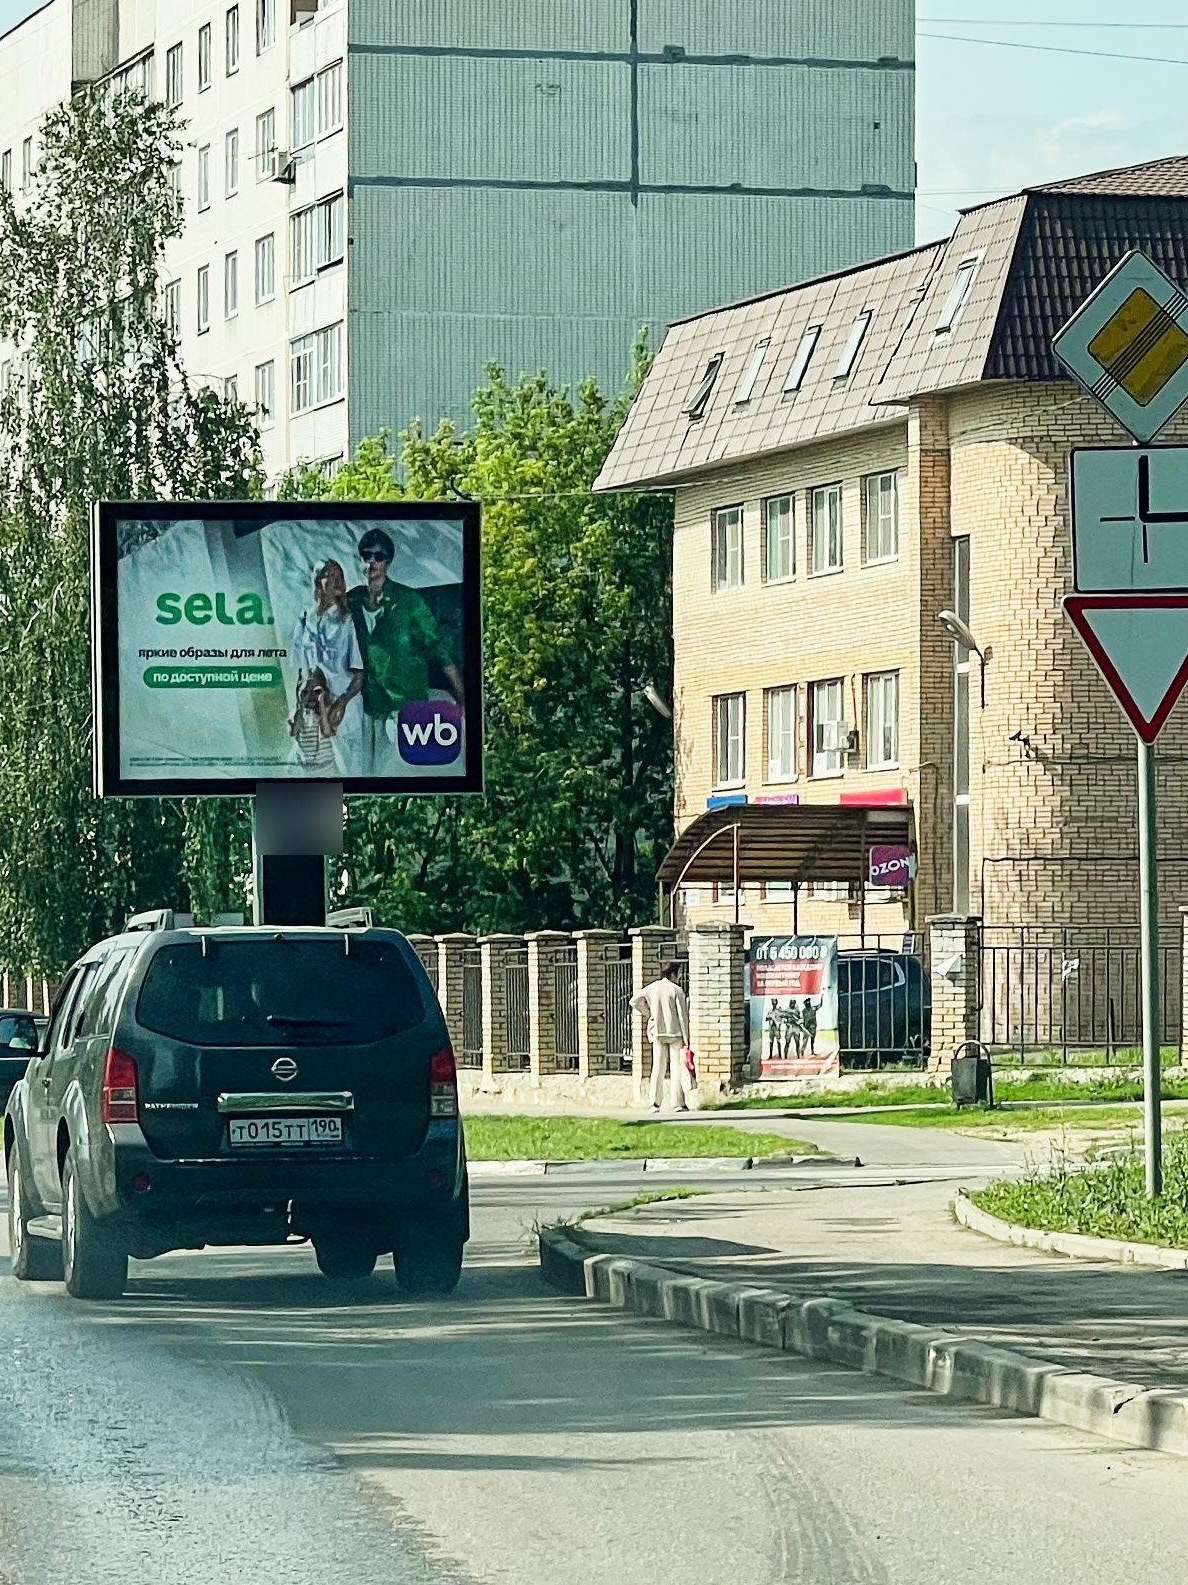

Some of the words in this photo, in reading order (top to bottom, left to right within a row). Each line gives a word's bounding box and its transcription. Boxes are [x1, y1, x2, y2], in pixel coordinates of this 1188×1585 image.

[156, 592, 275, 625] sela.
[138, 649, 177, 660] яркие
[179, 647, 228, 660] образы
[230, 649, 255, 660] для
[257, 649, 287, 658] лета
[153, 673, 170, 682] по
[171, 670, 239, 685] доступной
[241, 673, 273, 684] цене
[401, 713, 458, 746] wb
[871, 856, 911, 876] OZON
[778, 946, 798, 960] 450
[799, 946, 819, 960] 000
[236, 1121, 306, 1140] Т015ТТ
[311, 1120, 337, 1134] 190
